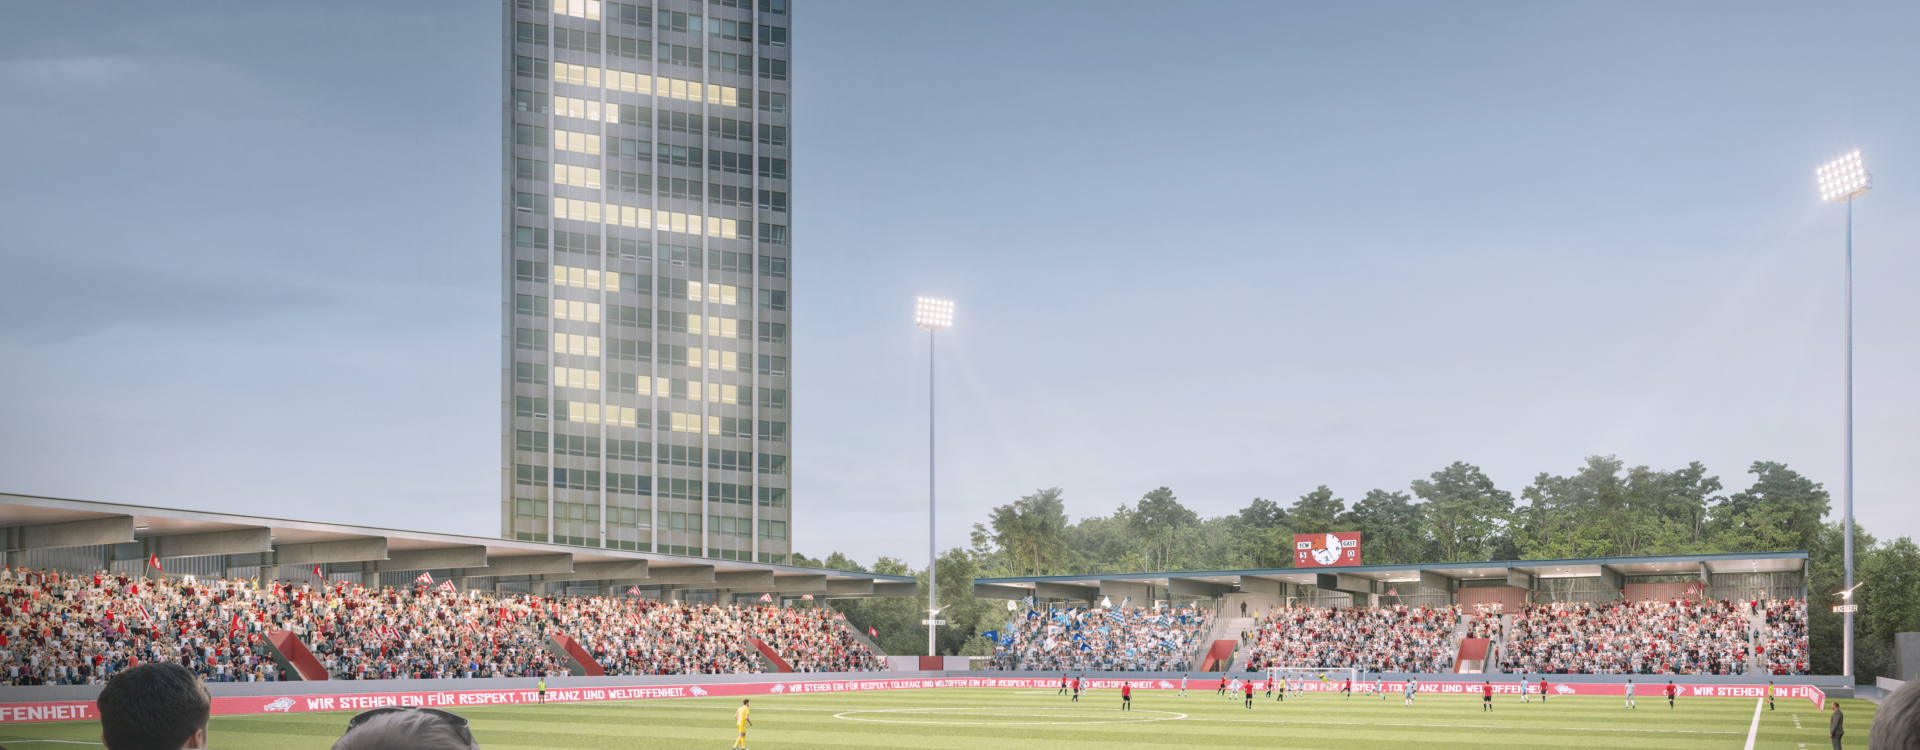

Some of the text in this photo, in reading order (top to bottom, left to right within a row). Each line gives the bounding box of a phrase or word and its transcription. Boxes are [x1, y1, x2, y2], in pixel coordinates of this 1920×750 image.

[790, 684, 803, 692] WIR
[804, 683, 831, 692] STEHEN
[833, 682, 844, 691] EIN
[845, 682, 859, 691] FÜR
[860, 681, 891, 690] RESPEKT,
[891, 681, 921, 689] TOLERANZ
[922, 680, 934, 688] UND
[982, 679, 996, 687] FÜR
[998, 679, 1033, 688] RESPEKT,
[1033, 680, 1071, 688] TOLERAZ
[1303, 683, 1318, 691] EIN
[1388, 684, 1439, 692] TOLANZ
[1442, 684, 1461, 693] UND
[1693, 687, 1714, 696] WIR
[1718, 687, 1764, 696] STEHEN
[307, 698, 335, 710] WIR
[340, 696, 396, 708] STEHEN
[401, 695, 423, 706] EIN
[428, 693, 455, 705] FÜR
[459, 692, 519, 704] RESPEKT,
[583, 690, 605, 700] UND
[608, 687, 686, 699] WELTOFFENHEIT.
[0, 705, 93, 721] FENHEIT.
